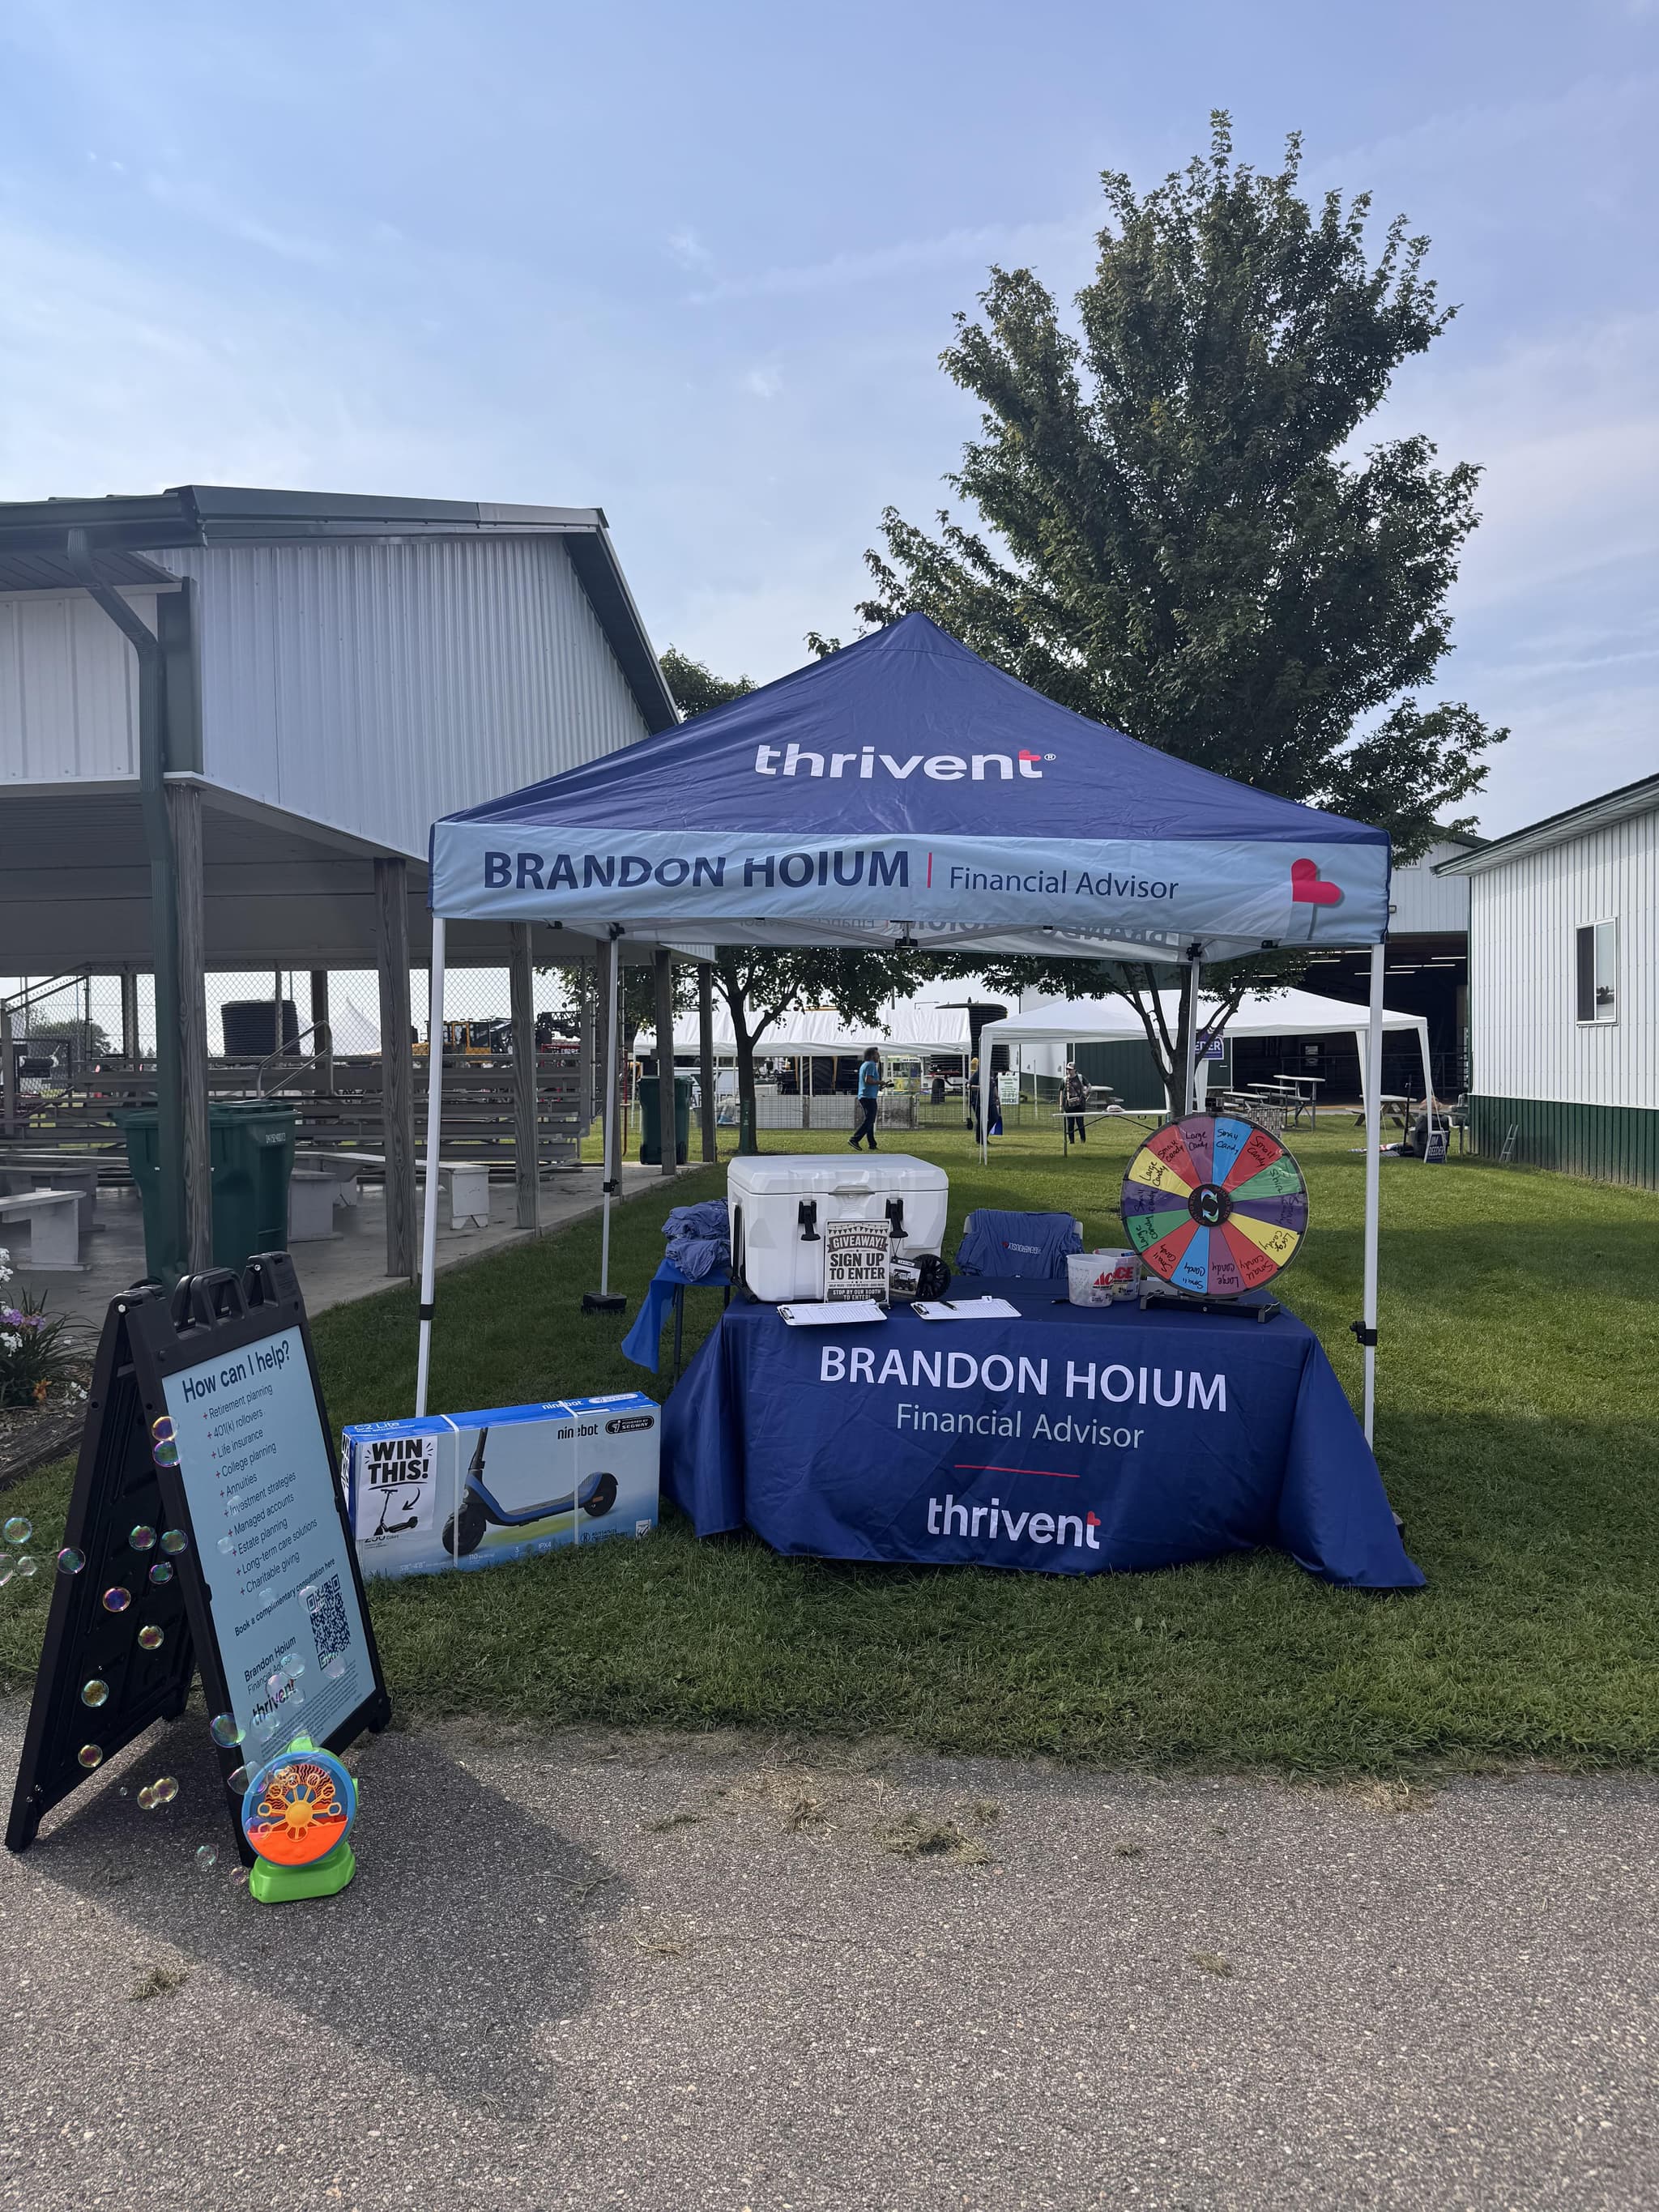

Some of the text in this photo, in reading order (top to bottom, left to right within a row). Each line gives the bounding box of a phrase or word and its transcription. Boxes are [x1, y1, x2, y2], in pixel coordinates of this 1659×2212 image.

[484, 850, 1179, 899] BRANDON HOIUM Financial Advisor
[1185, 1131, 1207, 1141] Large
[1249, 1136, 1276, 1159] Small
[1139, 1161, 1158, 1182] Large
[833, 1236, 885, 1248] GIVEAWAY!
[829, 1267, 885, 1281] TO ENTER
[830, 1253, 862, 1267] SIGN
[866, 1252, 884, 1266] UP
[1113, 1266, 1134, 1279] CE
[1217, 1274, 1239, 1288] Large
[181, 1340, 290, 1403] How can I help?
[820, 1345, 1227, 1412] BRANDON HOIUM
[208, 1384, 273, 1419] Retirement planning
[214, 1409, 263, 1438] 401(k) rollovers
[897, 1403, 1145, 1449] Financial Advisor
[217, 1429, 263, 1459] Life insurance
[221, 1443, 276, 1477] College planning
[372, 1438, 423, 1462] WIN
[227, 1473, 258, 1497] Annuities
[368, 1459, 429, 1484] THIS!
[229, 1472, 296, 1515] Investment strategies
[233, 1494, 295, 1536] Managed accounts
[928, 1494, 1102, 1549] thrivent
[237, 1518, 288, 1555] Estate planning
[241, 1519, 318, 1574] Long-term care solutions
[245, 1551, 300, 1593] Charitable giving
[234, 1620, 250, 1636] Book
[255, 1588, 296, 1621] complimentary
[296, 1566, 324, 1592] consultation
[324, 1558, 335, 1570] here
[244, 1636, 296, 1682] Brandon Hoium
[247, 1669, 272, 1695] Financial
